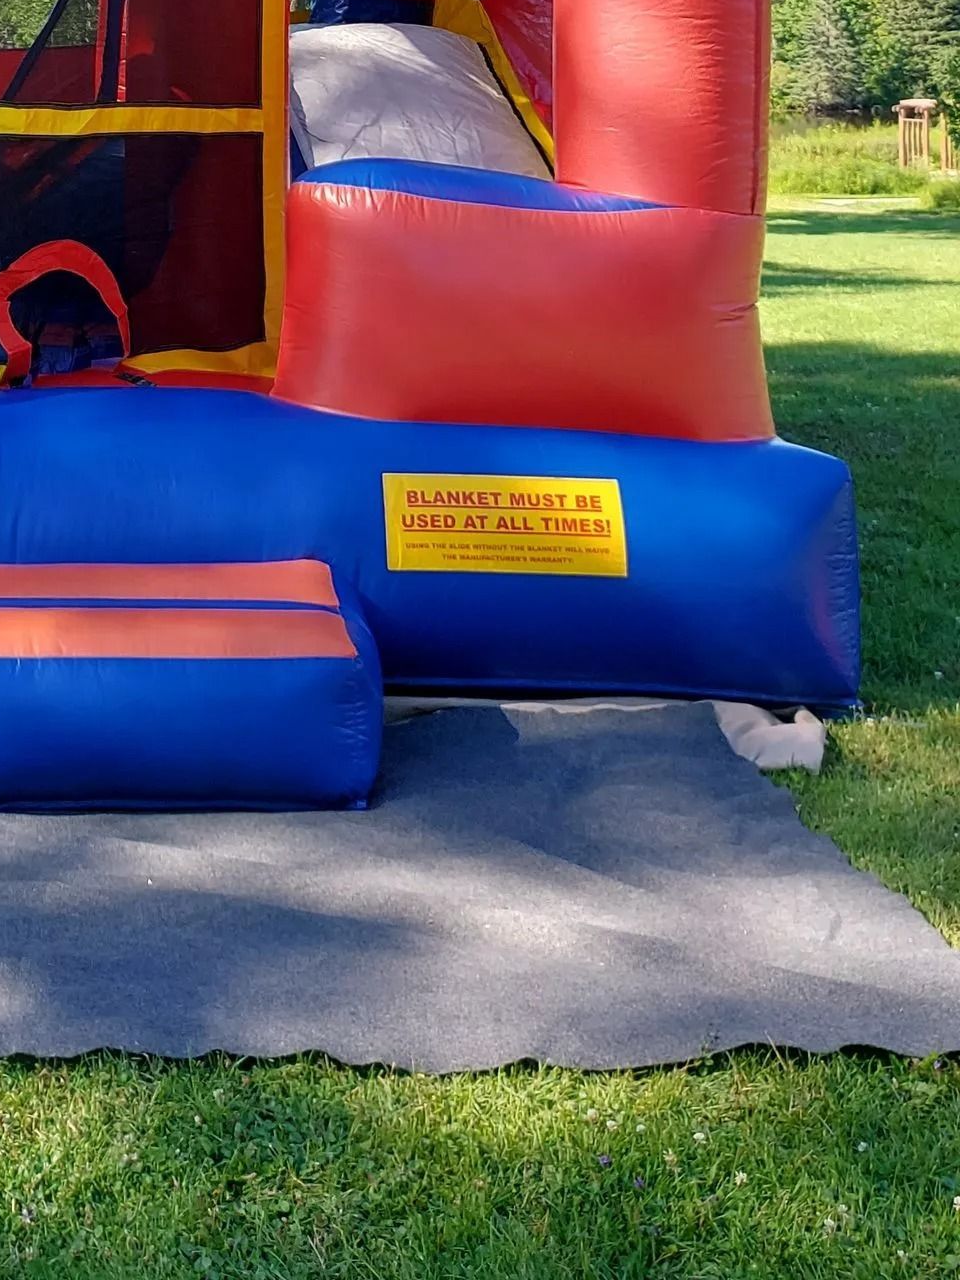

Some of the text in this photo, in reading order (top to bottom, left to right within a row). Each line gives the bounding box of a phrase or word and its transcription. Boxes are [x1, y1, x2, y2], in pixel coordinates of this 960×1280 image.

[406, 489, 602, 509] BLANKET MUST BE
[401, 513, 611, 533] USED AT ALL TIMES!
